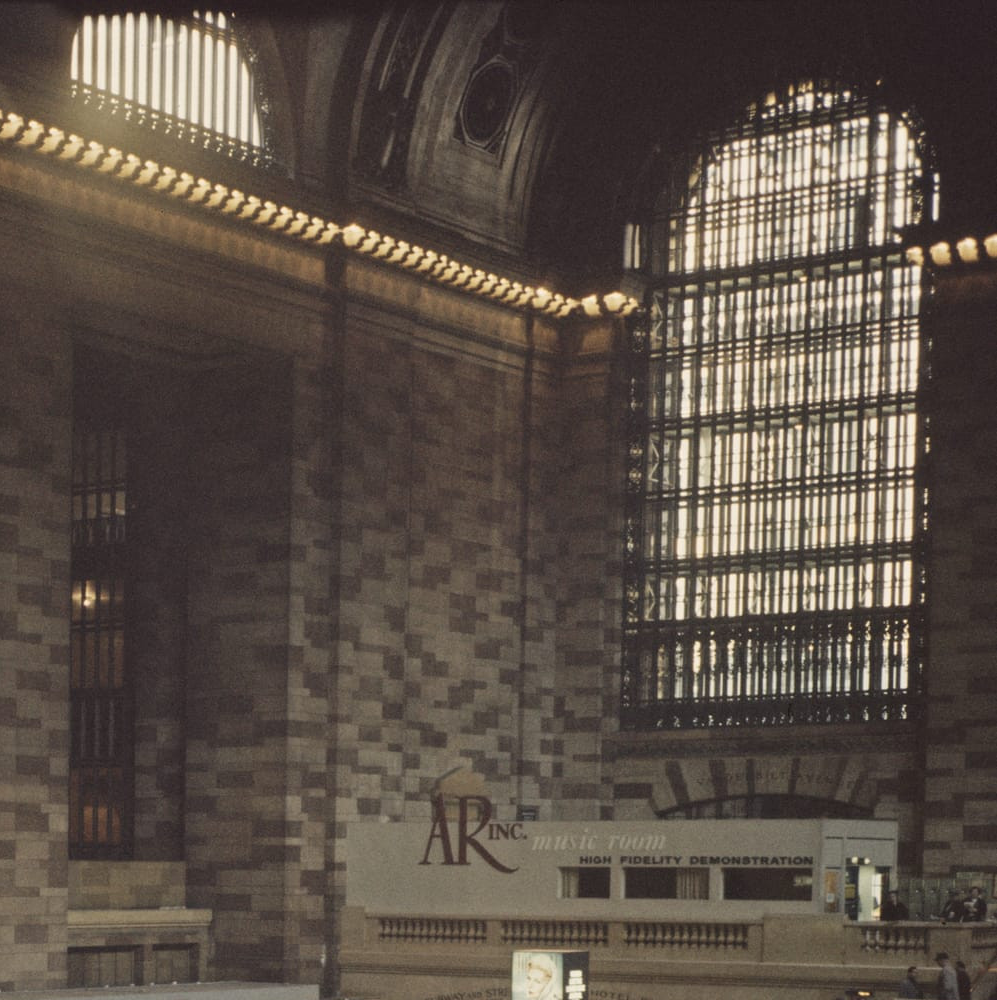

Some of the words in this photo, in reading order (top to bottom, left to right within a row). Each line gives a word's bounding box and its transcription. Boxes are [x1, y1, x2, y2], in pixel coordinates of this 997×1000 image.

[488, 823, 528, 841] INC.
[531, 828, 598, 851] music
[607, 833, 668, 851] room
[579, 855, 612, 865] HIGH
[620, 855, 683, 865] FIDELITY
[689, 855, 814, 866] DEMONSTRATION
